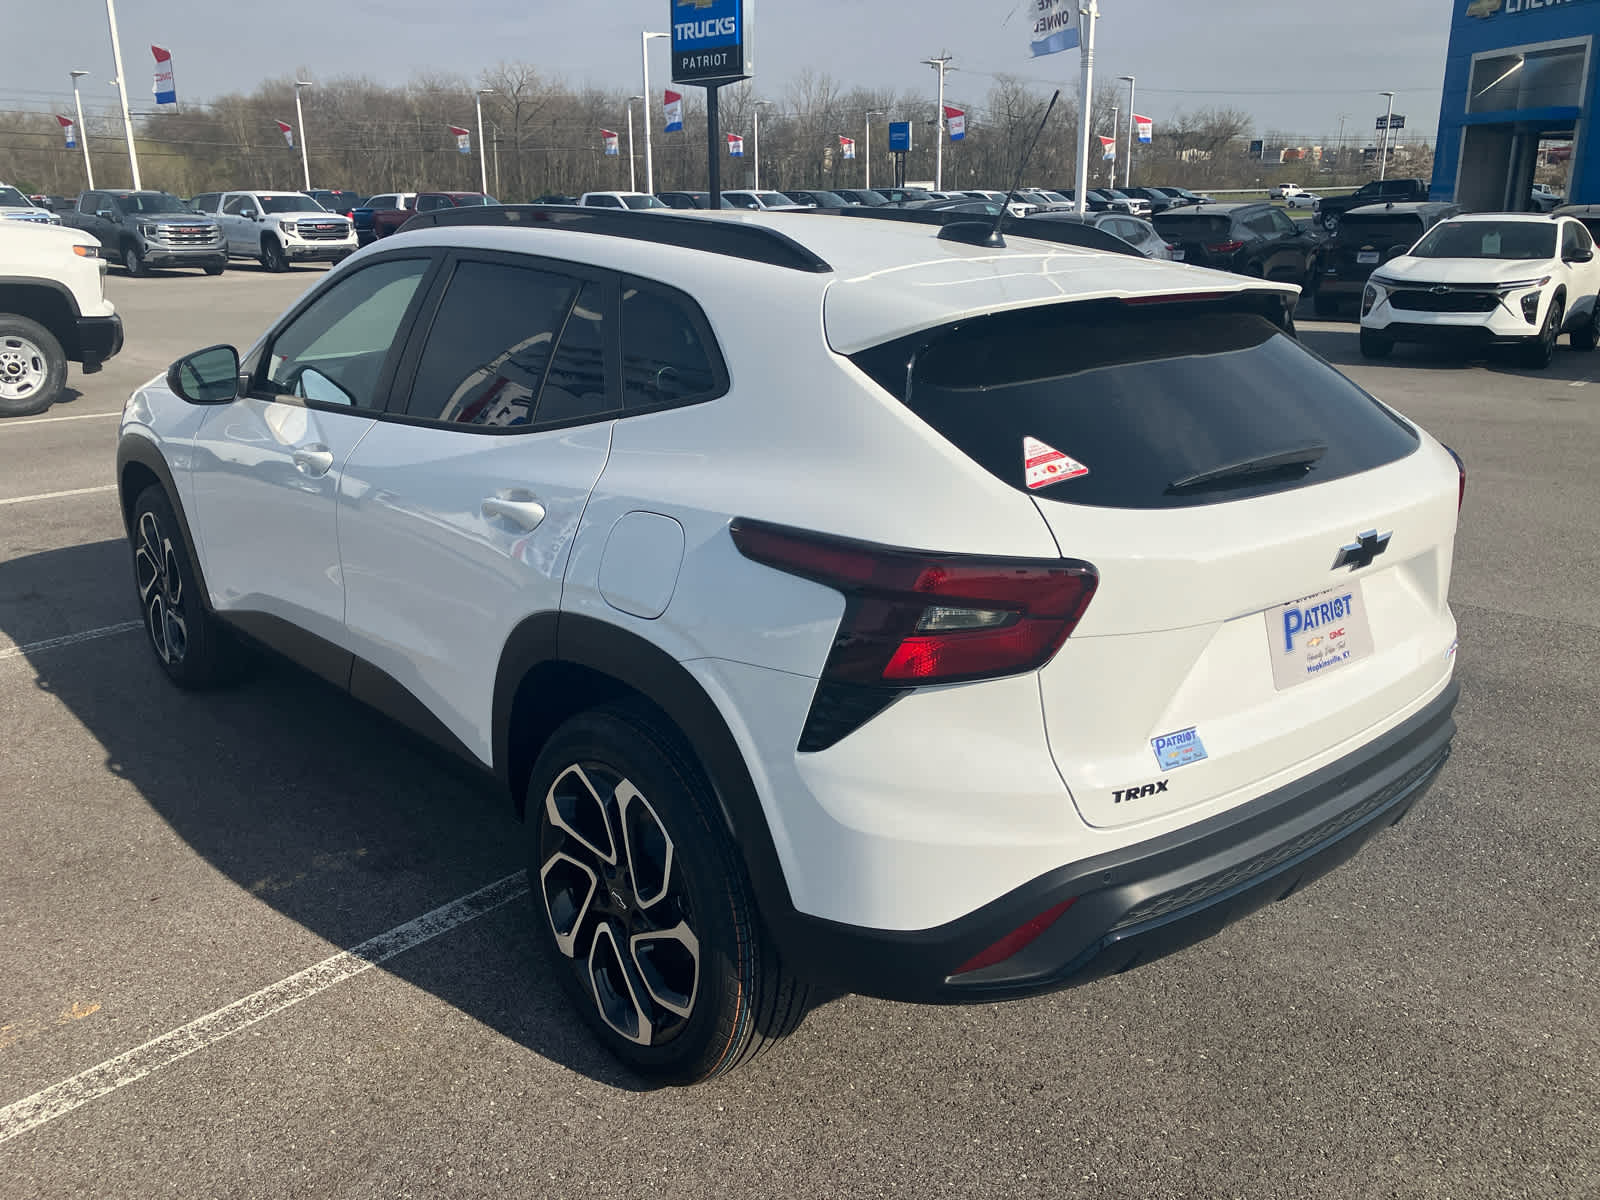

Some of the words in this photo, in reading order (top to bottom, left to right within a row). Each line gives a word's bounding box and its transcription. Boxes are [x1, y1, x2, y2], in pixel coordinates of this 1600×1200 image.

[674, 16, 735, 40] TRUCKS
[682, 53, 727, 69] PATRIOT
[1283, 594, 1352, 651] PATRIOT
[1155, 730, 1196, 756] PATRIOT
[1112, 779, 1168, 803] TRAX
